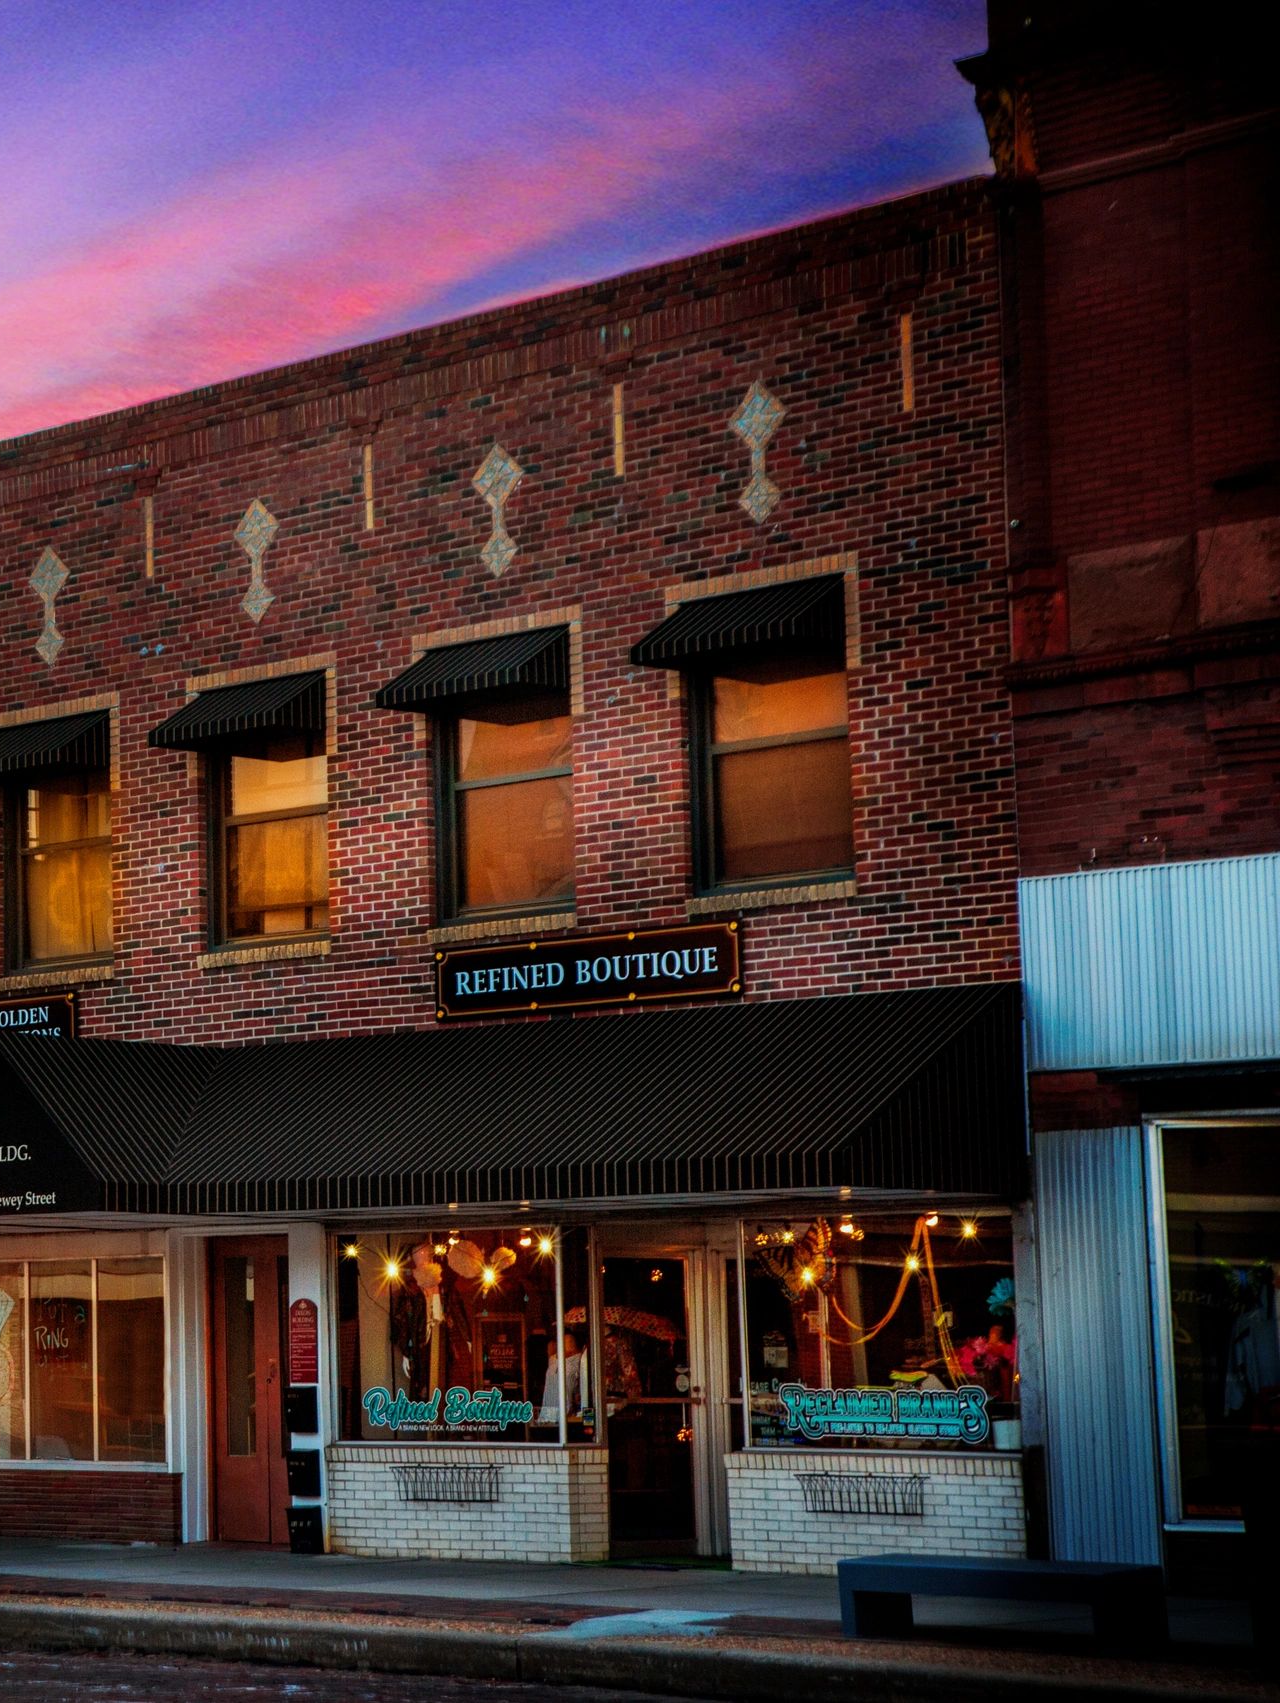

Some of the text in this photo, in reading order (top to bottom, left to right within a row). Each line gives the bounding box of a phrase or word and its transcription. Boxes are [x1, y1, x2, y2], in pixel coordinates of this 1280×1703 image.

[455, 946, 719, 996] REFINED BOUTIQUE
[25, 1191, 56, 1205] Street
[363, 1385, 534, 1431] Refined Boutique
[781, 1385, 893, 1440] RECLAIMED
